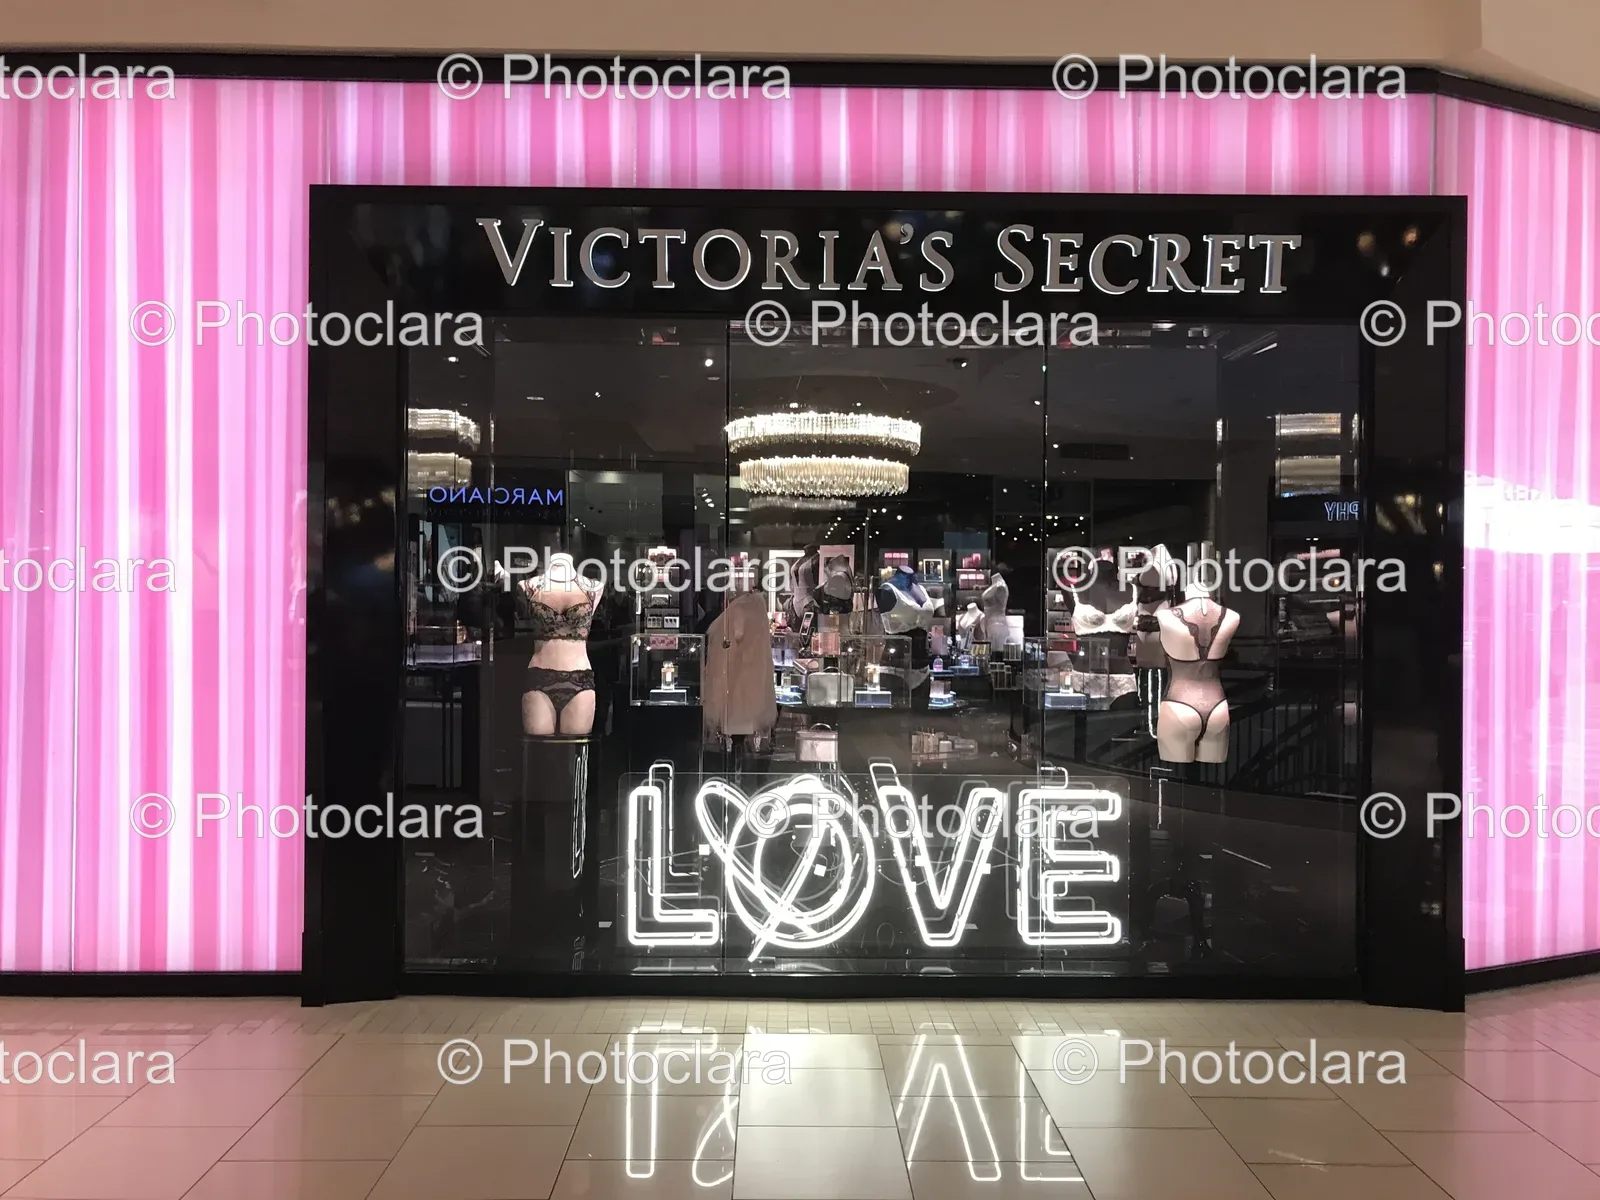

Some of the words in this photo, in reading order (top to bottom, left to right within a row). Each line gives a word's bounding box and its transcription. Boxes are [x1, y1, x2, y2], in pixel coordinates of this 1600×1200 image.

[476, 217, 955, 293] VICTORIA'S
[994, 223, 1303, 296] SECRET
[626, 773, 1123, 961] LOVE
